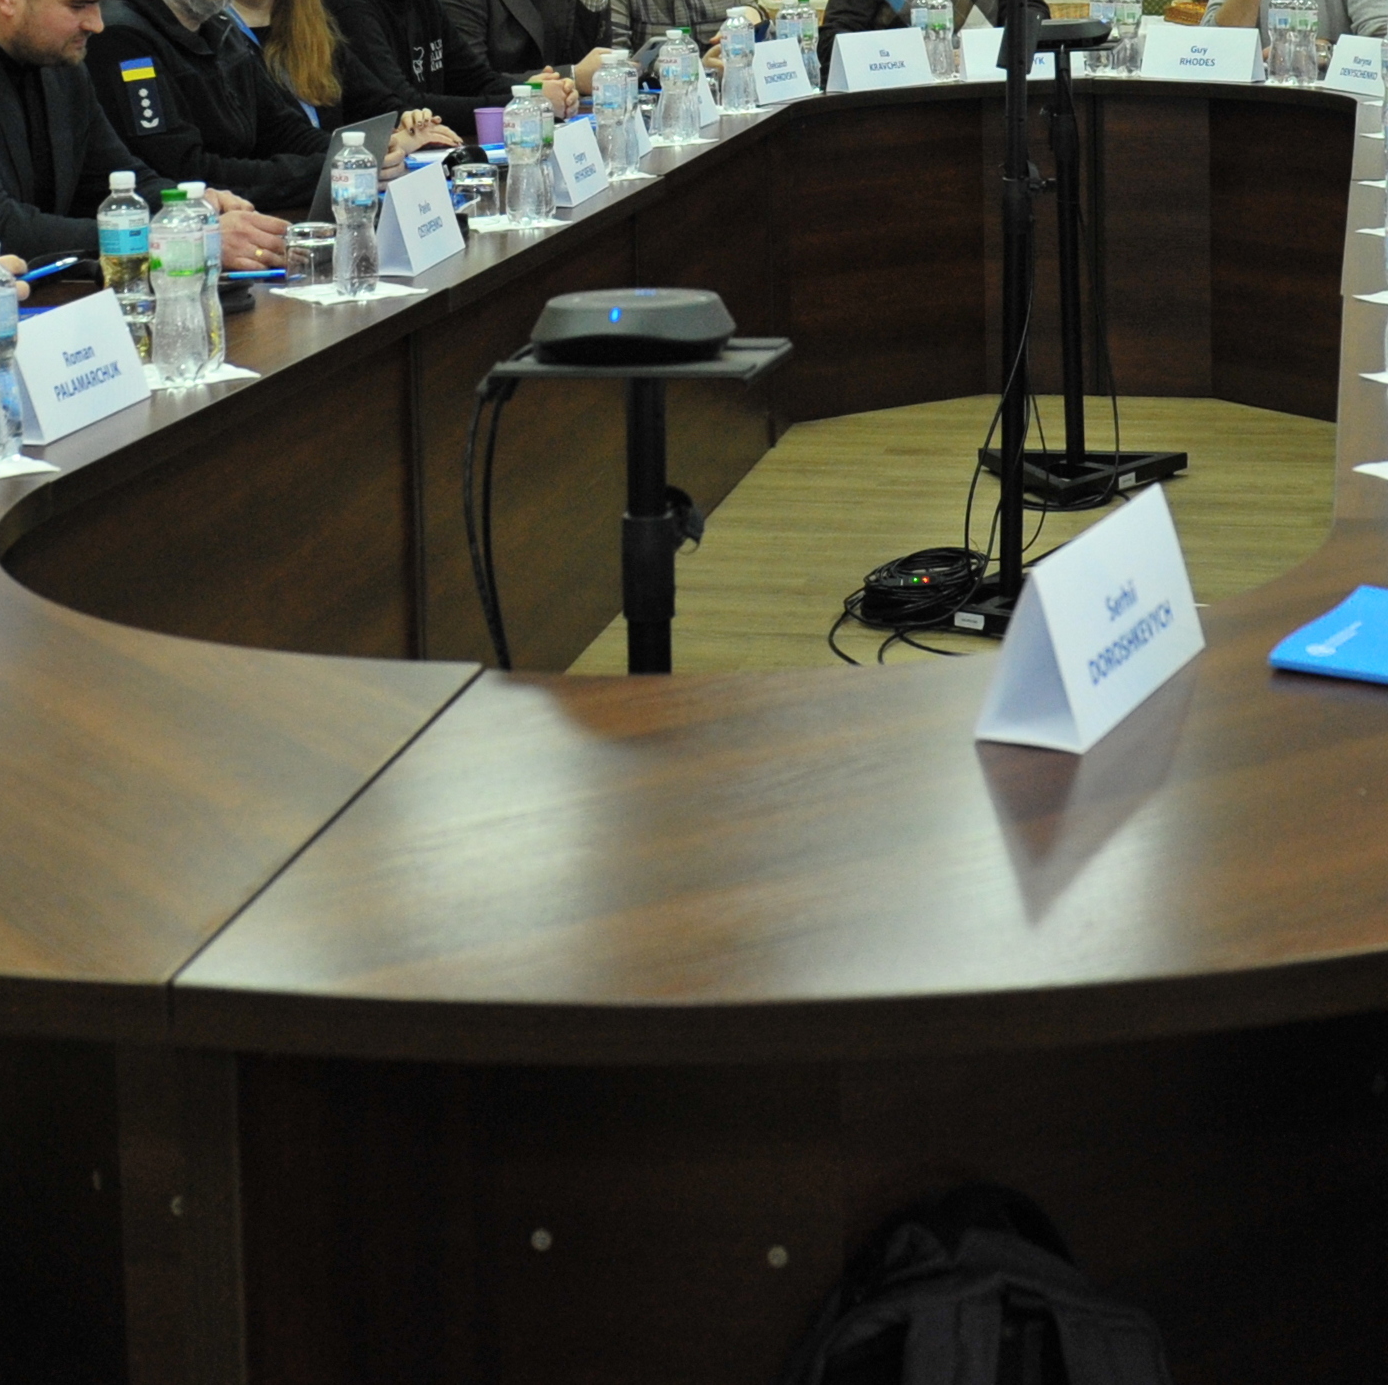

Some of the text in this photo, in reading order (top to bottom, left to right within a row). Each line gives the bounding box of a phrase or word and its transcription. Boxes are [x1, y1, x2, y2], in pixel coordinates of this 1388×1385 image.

[1190, 45, 1208, 56] Guy
[869, 60, 906, 72] KRAVCHUK
[1179, 57, 1216, 67] RHODES
[62, 345, 95, 367] Roman
[53, 360, 122, 402] PALAMARCHUK
[1105, 578, 1138, 622] Serhii
[1088, 599, 1174, 685] DOROSHKEVYCH
